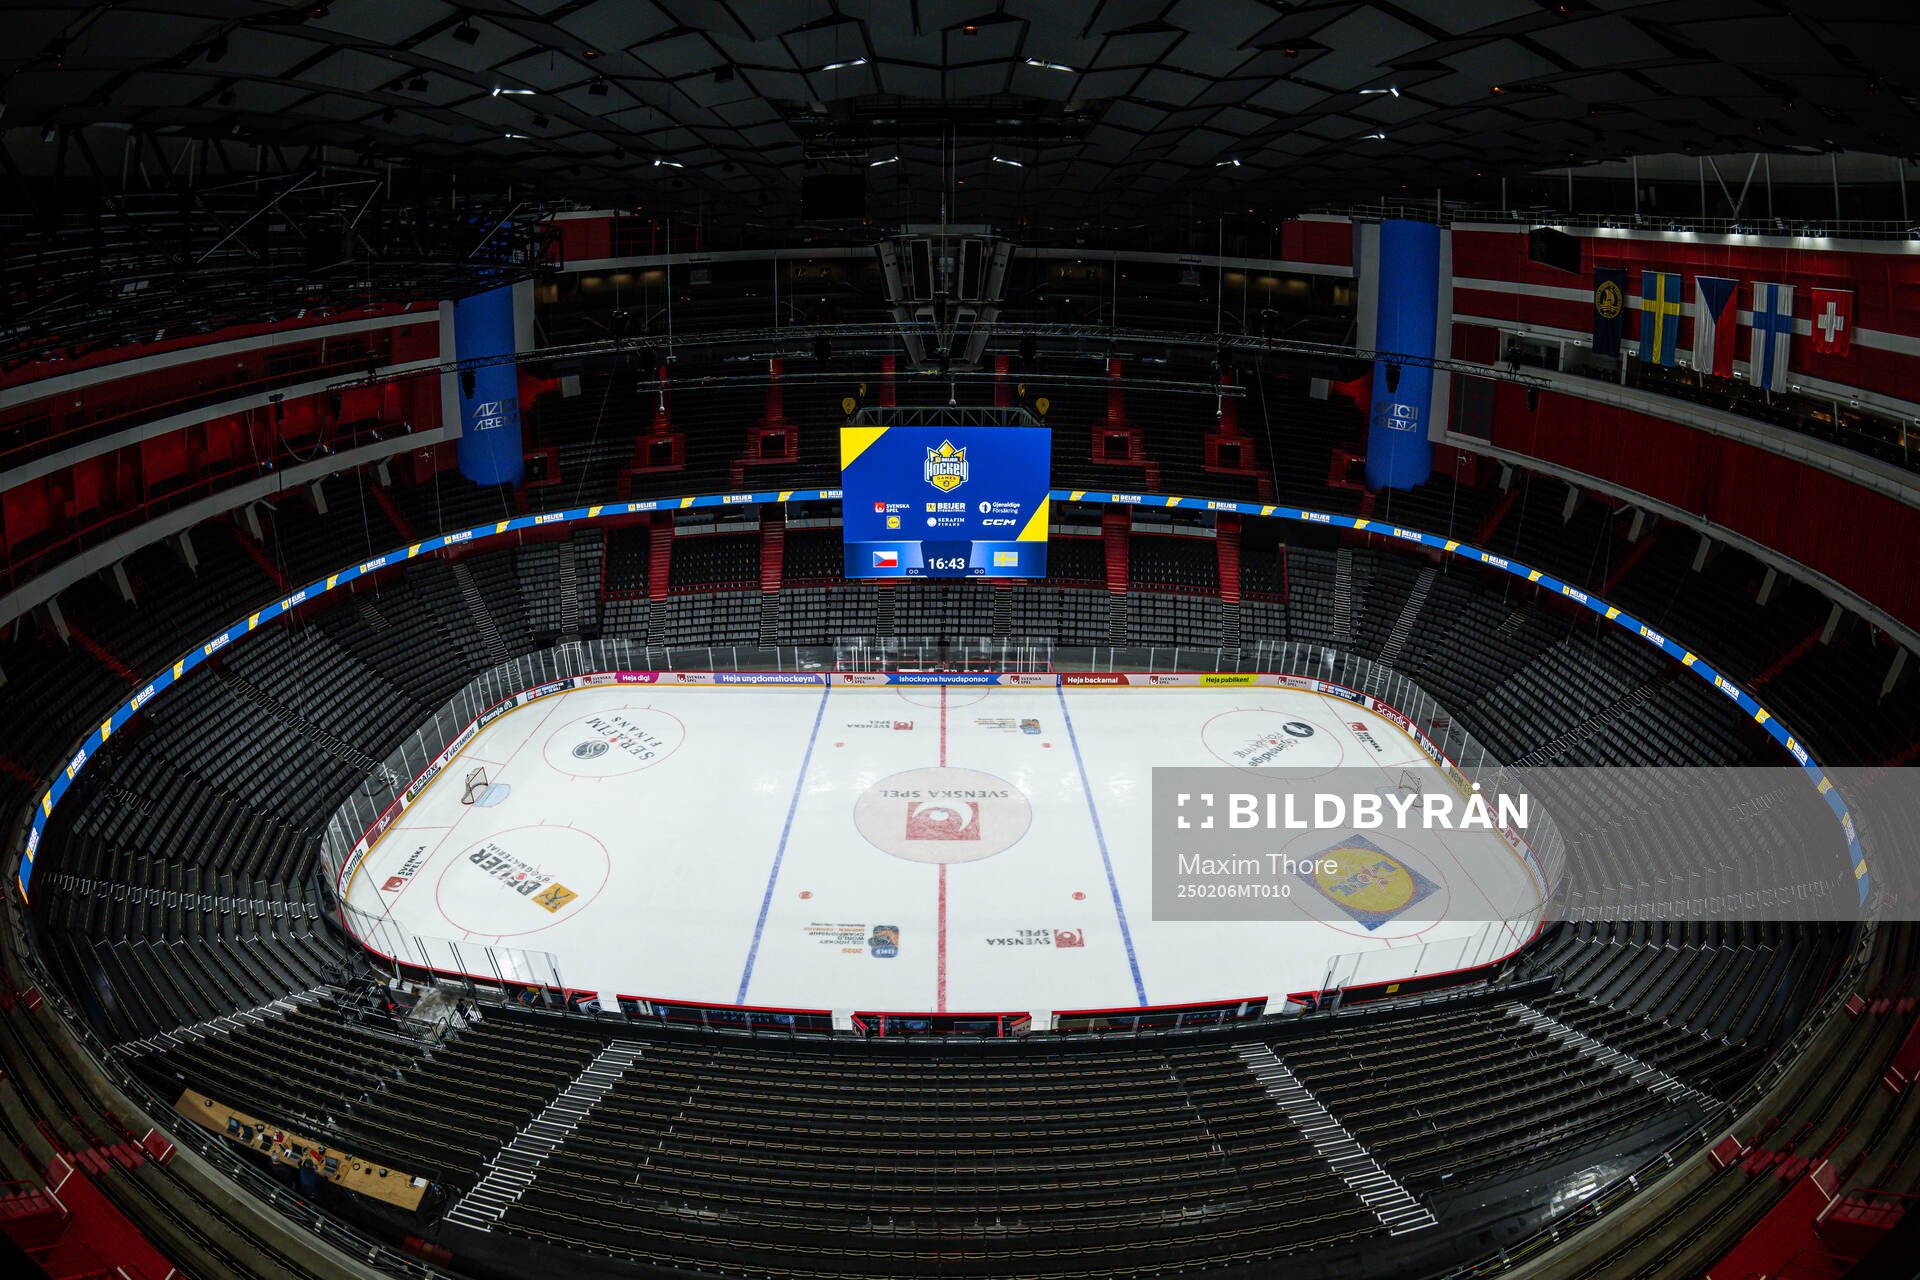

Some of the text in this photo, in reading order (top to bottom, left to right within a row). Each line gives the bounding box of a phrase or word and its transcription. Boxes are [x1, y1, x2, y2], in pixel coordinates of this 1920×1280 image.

[366, 556, 386, 568] BEIJER
[928, 558, 965, 569] 16:43
[1489, 555, 1508, 567] BEIJER
[288, 591, 306, 606] BEIJER
[1570, 588, 1588, 602] BEIJER
[210, 633, 229, 648] BEIJER
[1647, 629, 1665, 645] BEIJER
[723, 675, 741, 683] Heja
[1067, 676, 1084, 684] Heja
[1220, 676, 1249, 684] publiken!
[480, 707, 504, 725] Plannja
[1376, 703, 1408, 729] Scandic
[586, 717, 655, 761] SERAFIM
[611, 716, 663, 748] FINANS
[1363, 732, 1382, 752] SVENSKA
[1420, 735, 1438, 760] NOCCO
[412, 763, 438, 792] SPARX
[1487, 807, 1520, 848] CM
[342, 848, 363, 884] Thermia
[398, 846, 426, 875] SVENSKA
[405, 860, 422, 877] SPEL
[986, 938, 1051, 946] SVENSKA
